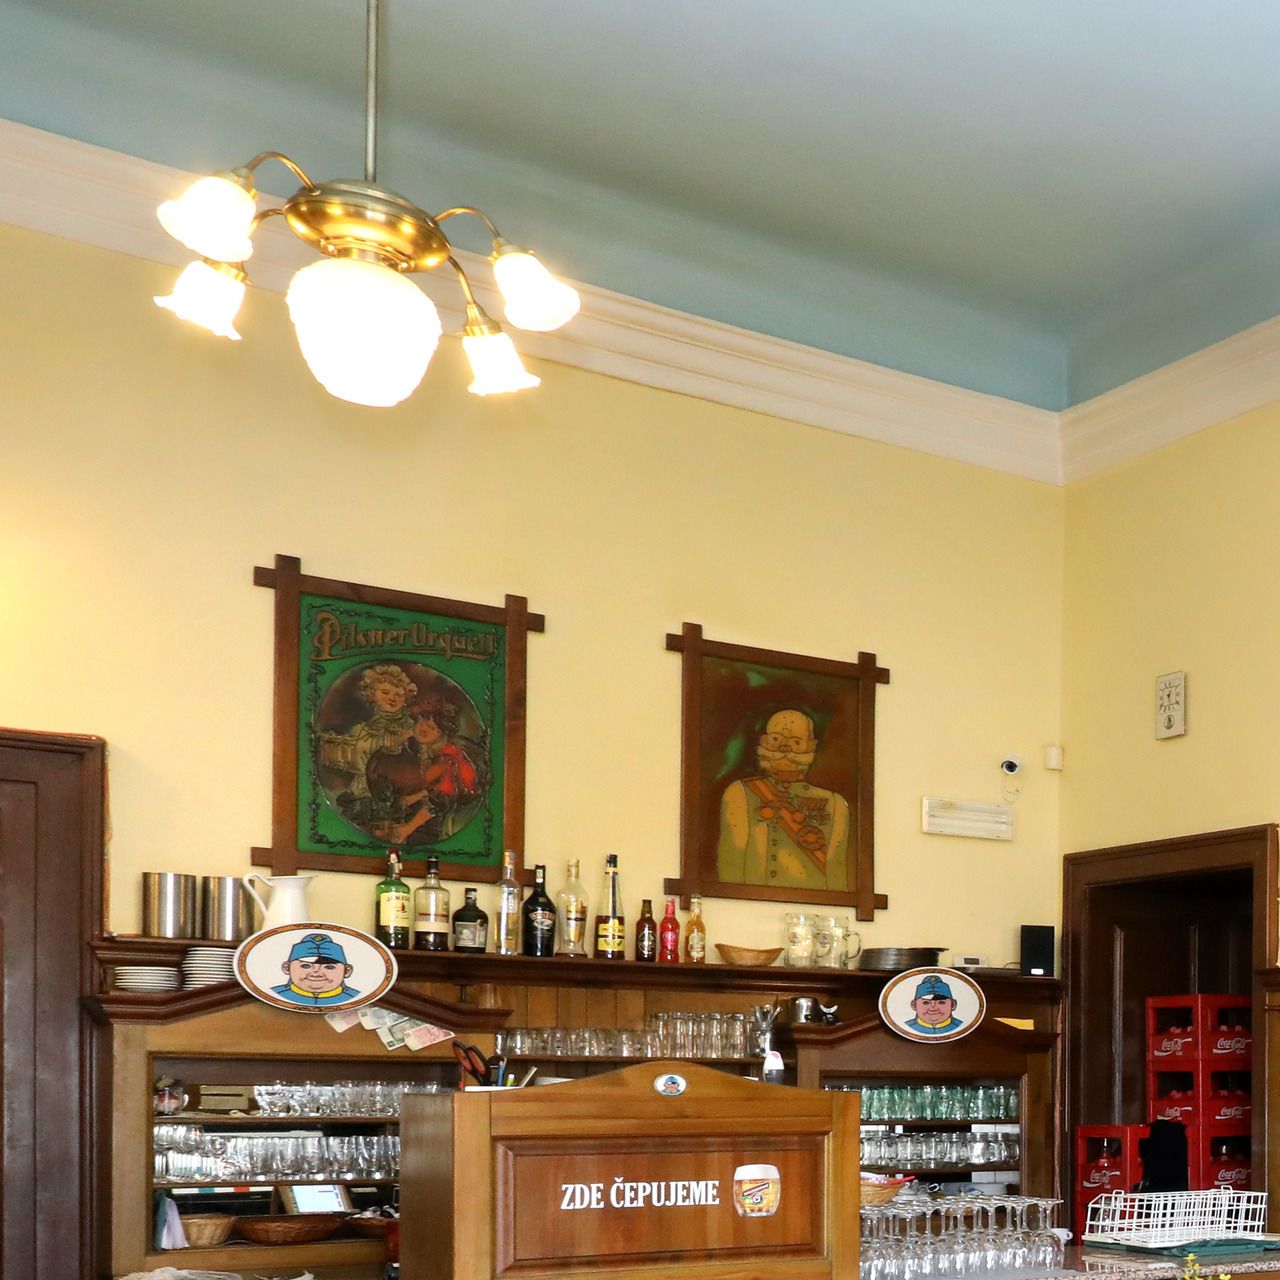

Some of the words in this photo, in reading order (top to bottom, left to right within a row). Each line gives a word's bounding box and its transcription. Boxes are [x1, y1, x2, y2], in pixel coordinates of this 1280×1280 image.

[310, 611, 410, 661] Pilsner
[410, 623, 497, 660] Urquell
[560, 1183, 604, 1209] ZDE
[610, 1177, 720, 1208] ČEPUJEME
